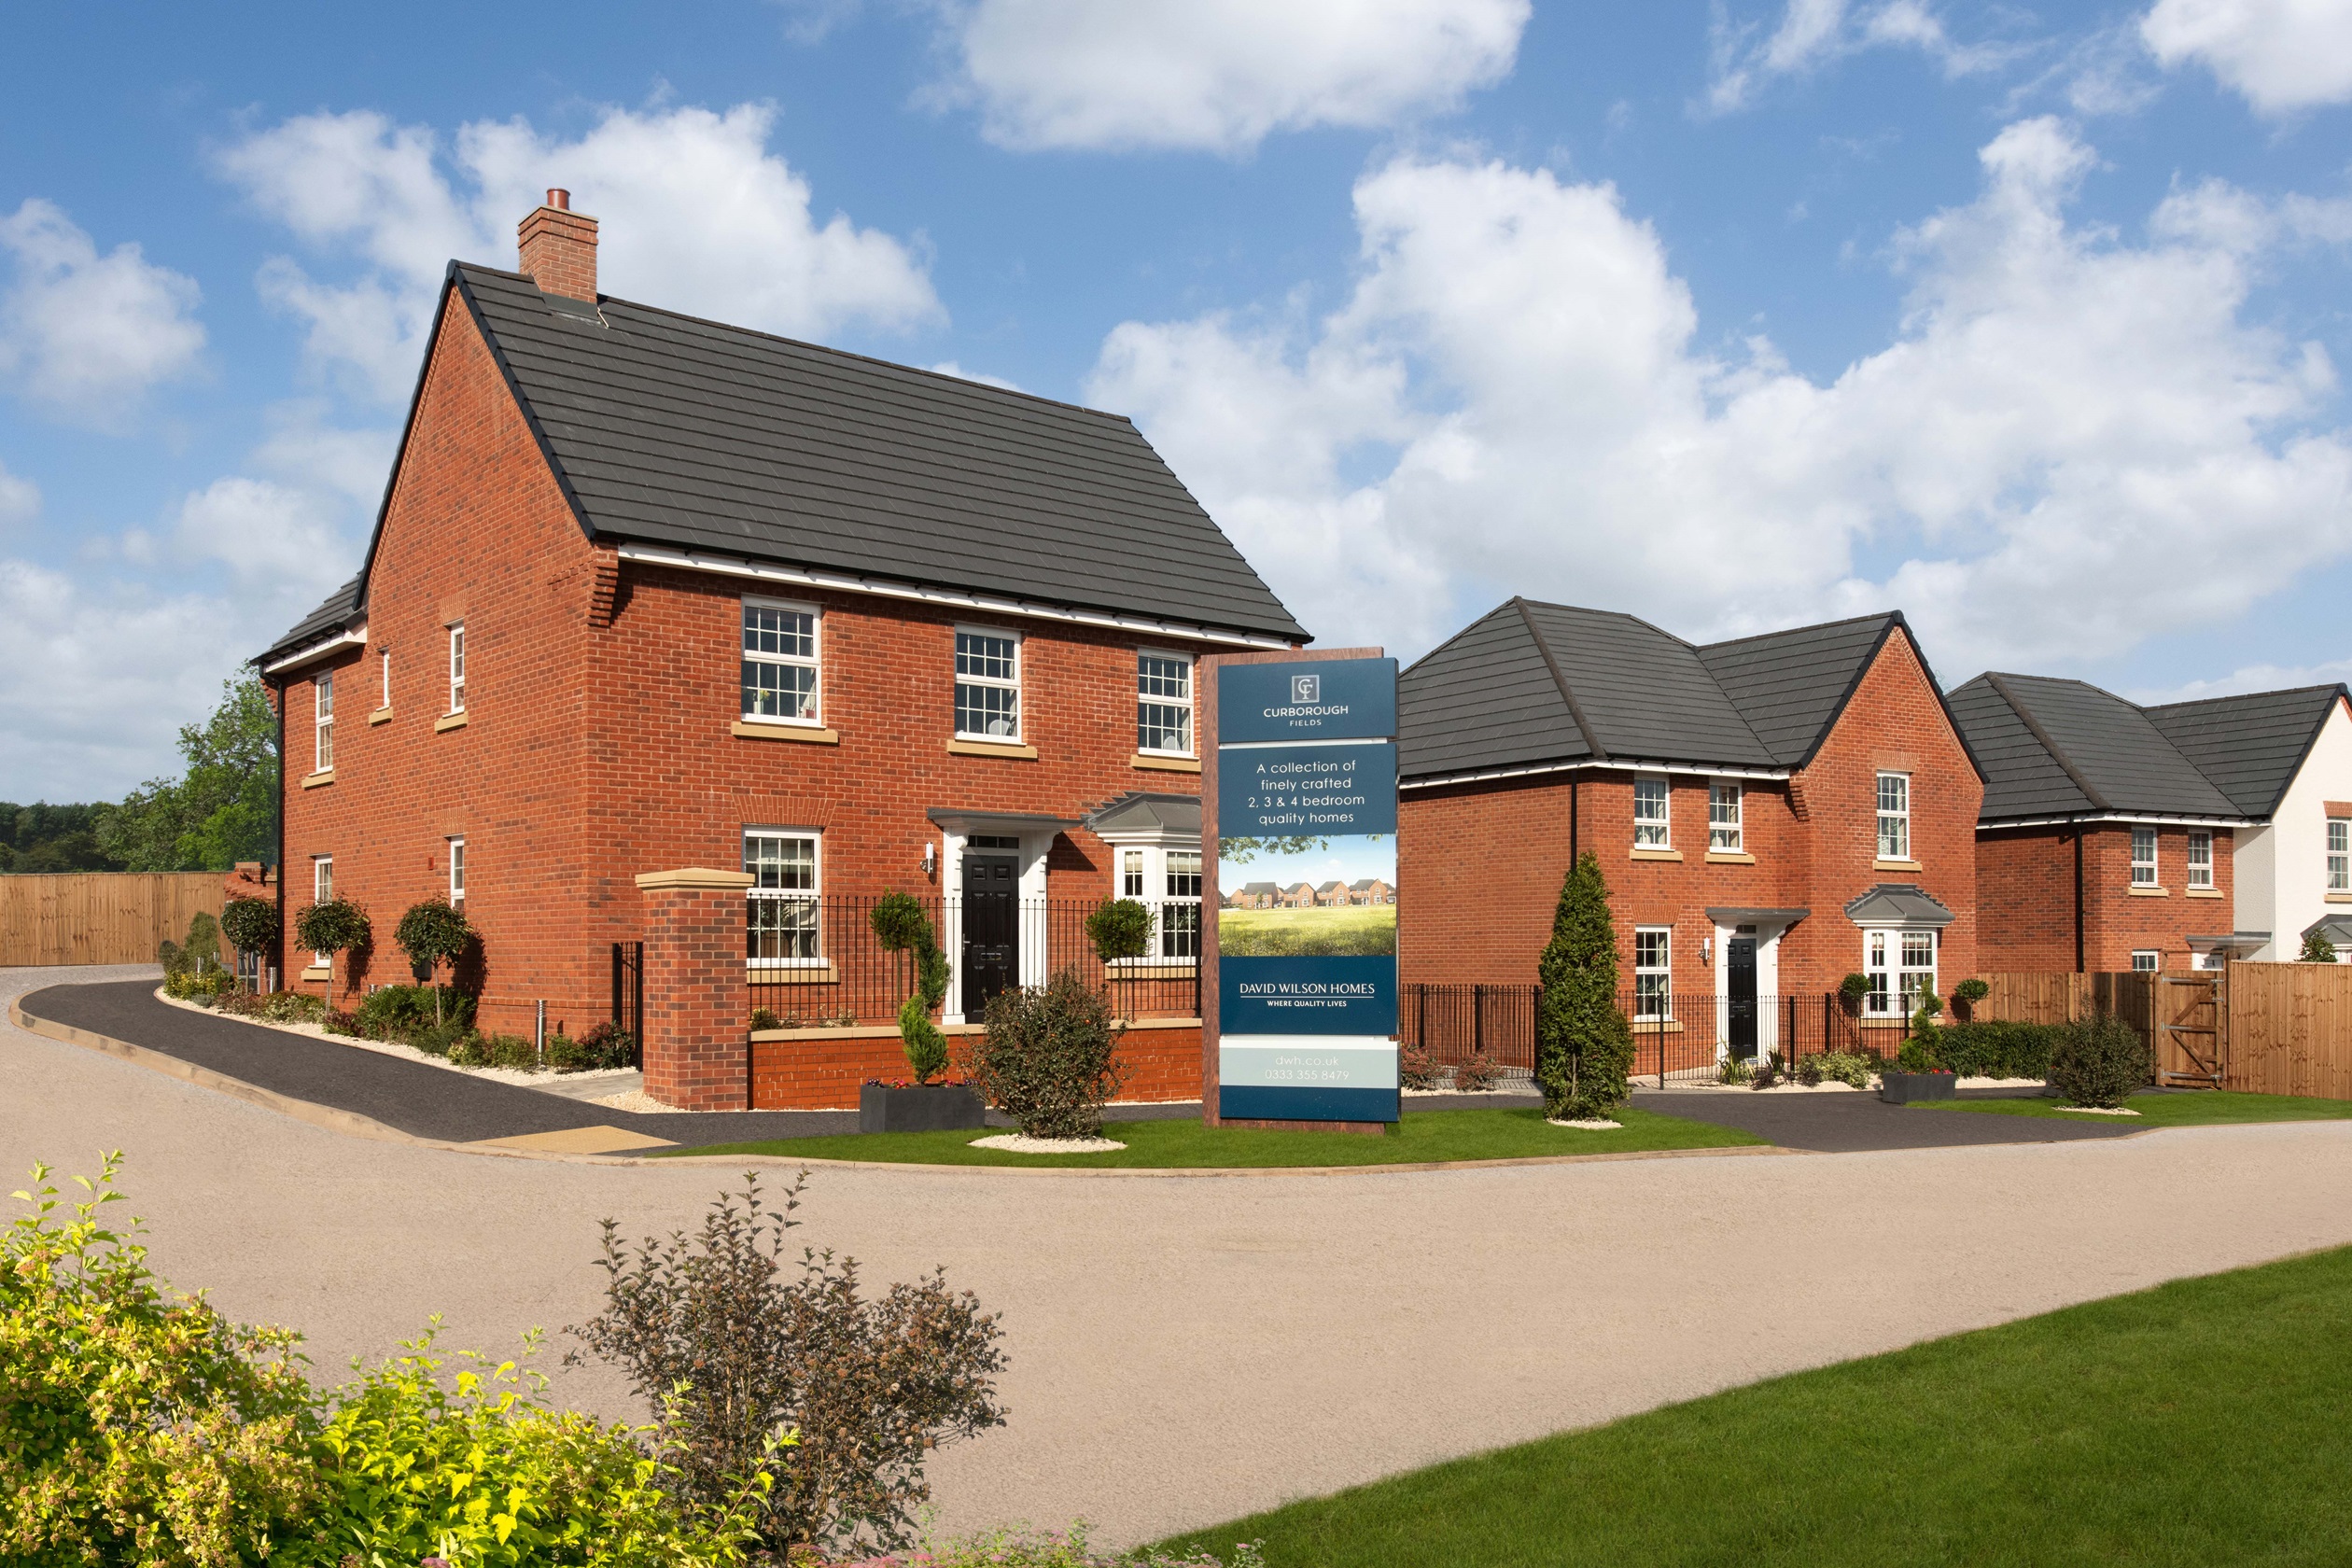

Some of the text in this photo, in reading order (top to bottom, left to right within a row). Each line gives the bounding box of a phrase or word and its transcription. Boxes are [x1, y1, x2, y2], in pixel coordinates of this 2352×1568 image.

[1263, 706, 1349, 718] CURBOROUGH
[1256, 760, 1356, 774] A collection of
[1261, 777, 1351, 791] finely crafted
[1248, 795, 1365, 809] 2, 3 & 4 bedroom
[1259, 812, 1354, 826] quality homes
[1239, 983, 1375, 994] DAVID WILSON HOMES
[1275, 1056, 1339, 1066] dwh.co.uk
[1265, 1070, 1350, 1081] 0333 355 8479
